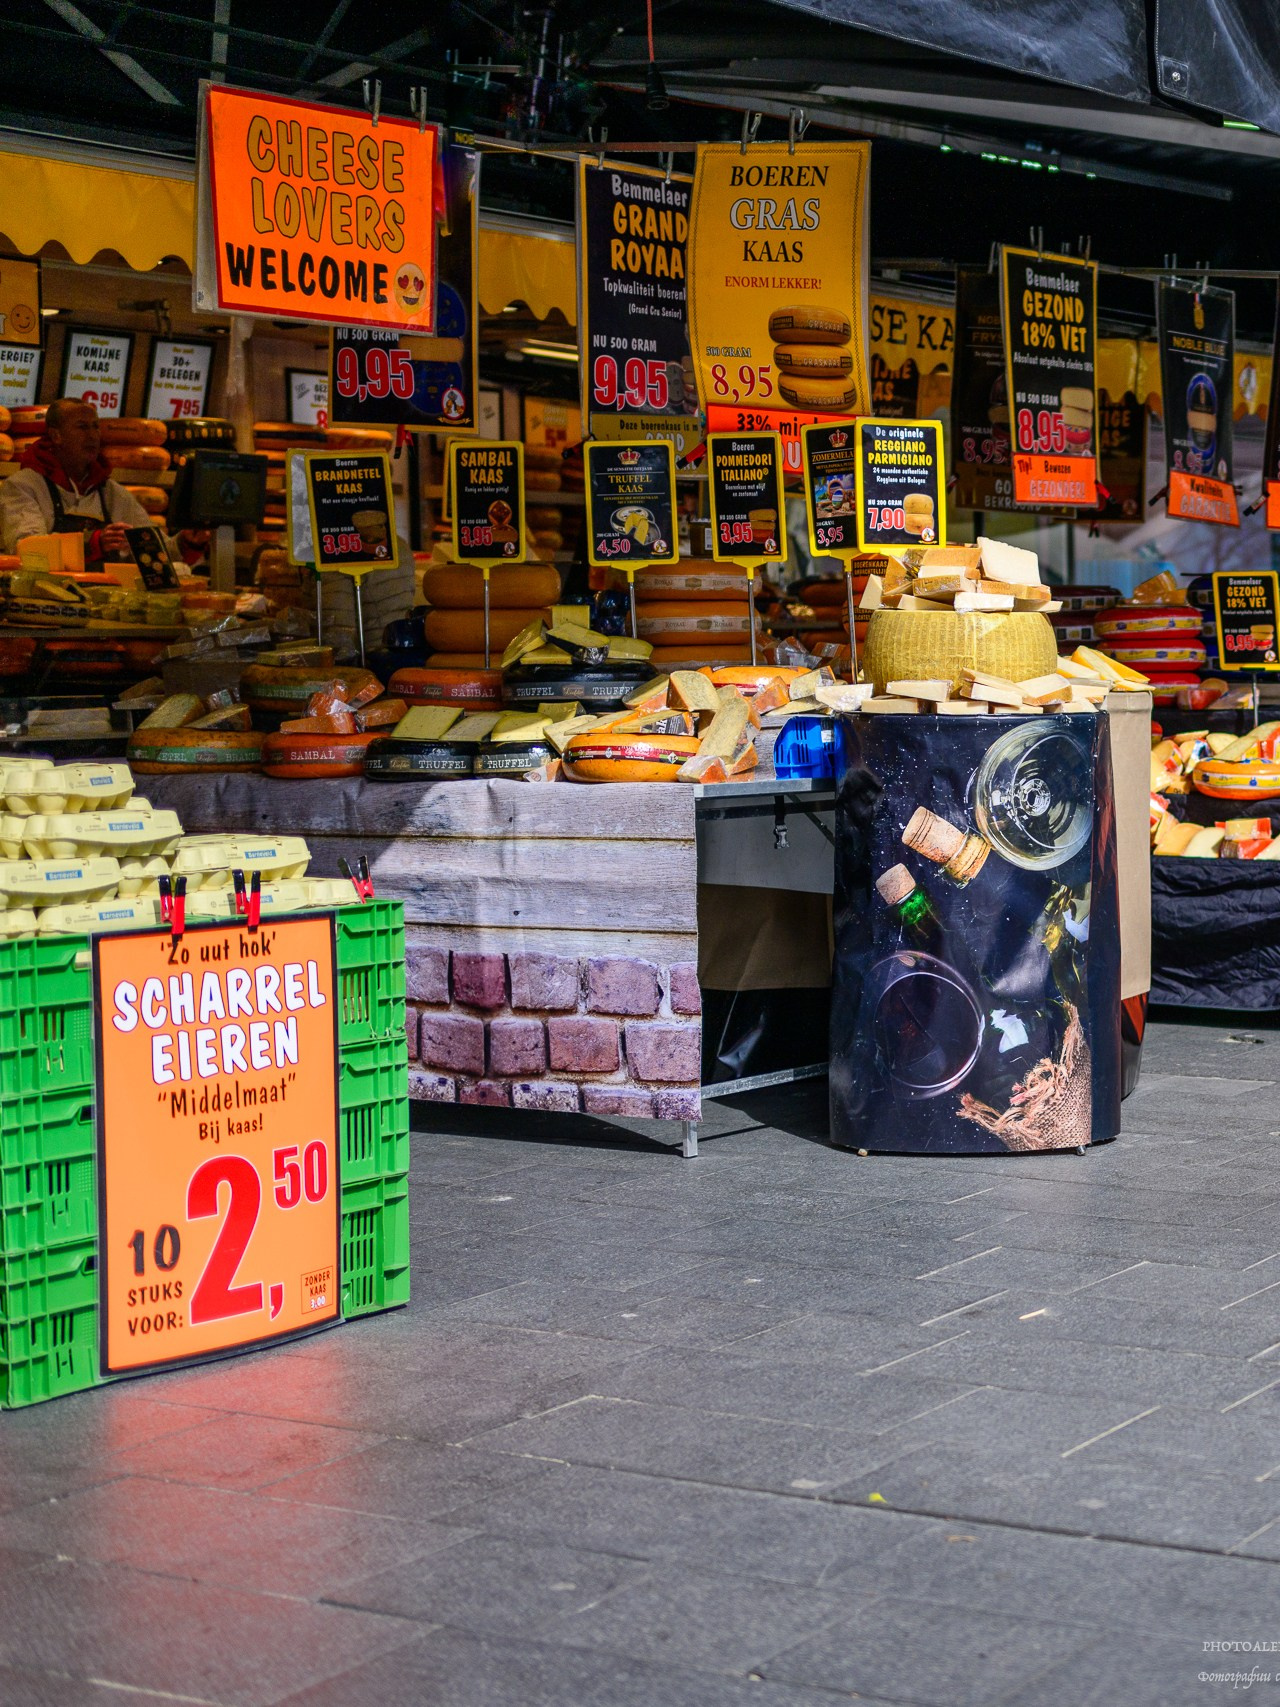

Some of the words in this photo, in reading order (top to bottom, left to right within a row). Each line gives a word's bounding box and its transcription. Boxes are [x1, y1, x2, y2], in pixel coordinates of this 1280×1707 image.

[247, 114, 404, 193] CHEESE
[729, 165, 829, 187] BOEREN
[611, 174, 687, 207] Bemmelaer
[251, 176, 405, 254] LOVERS
[613, 201, 688, 243] GRAND
[730, 197, 821, 230] GRAS
[743, 240, 804, 263] KAAS
[225, 242, 388, 304] WELCOME
[1025, 267, 1080, 293] Bemmelaer
[603, 277, 654, 297] Topkwaliteit
[725, 275, 769, 289] ENORM
[772, 276, 822, 290] LEKKER!
[1022, 289, 1084, 323] GEZOND
[593, 335, 607, 348] NU
[610, 337, 628, 349] 500
[631, 337, 657, 352] GRAM
[1021, 320, 1055, 349] 18%
[1060, 326, 1087, 353] VET
[76, 345, 121, 361] KOMIJNE
[721, 347, 751, 357] GRAM
[1173, 336, 1203, 351] NOBLE
[1204, 342, 1226, 356] BLUE
[84, 359, 110, 373] KAAS
[173, 356, 190, 367] 30+
[159, 367, 201, 381] BELEGEN
[337, 347, 415, 403] 9,95
[594, 354, 668, 412] 9,95
[711, 364, 773, 403] 8,95
[1016, 392, 1026, 403] NU
[1028, 393, 1039, 404] 500
[1041, 394, 1059, 406] GRAM
[620, 419, 638, 430] Deze
[641, 419, 681, 431] boerenkaas
[737, 413, 771, 432] 33%
[1018, 408, 1066, 454] 8,95
[875, 426, 886, 436] De
[888, 427, 924, 440] originele
[732, 442, 754, 451] Boeren
[874, 439, 926, 453] REGGIANO
[335, 459, 358, 467] Boeren
[460, 450, 513, 467] SAMBAL
[716, 453, 772, 467] POMMEDORI
[868, 452, 933, 466] PARMIGIANO
[1017, 457, 1033, 475] Tip!
[1044, 460, 1071, 474] Bewezen
[315, 468, 381, 481] BRANDNETEL
[470, 468, 504, 484] KAAS
[608, 474, 652, 484] TRUFFEL
[336, 483, 363, 494] KAAS
[618, 484, 644, 493] KAAS
[1029, 478, 1086, 499] GEZONDER!
[1190, 478, 1223, 498] Kwaliteits
[1180, 494, 1231, 521] GARANTIE
[868, 507, 905, 531] 7,90
[461, 526, 493, 547] 3,95
[720, 522, 752, 545] 3,95
[817, 526, 844, 546] 3,95
[323, 534, 362, 555] 3,95
[597, 538, 631, 557] 4,50
[1227, 586, 1265, 597] GEZOND
[1226, 597, 1246, 608] 18%
[1249, 597, 1267, 607] VET
[1225, 634, 1255, 652] 8,95
[450, 687, 496, 698] SAMBAL
[516, 686, 554, 696] TRUFFEL
[290, 750, 336, 760] SAMBAL
[487, 758, 532, 769] TRUFFEL
[418, 760, 466, 769] TRUFFEL
[110, 822, 141, 831] Barneveld
[49, 871, 80, 881] Barneveld
[100, 910, 132, 920] Barneveld
[201, 940, 230, 963] uut
[112, 959, 326, 1033] SCHARREL
[151, 1016, 299, 1085] EIEREN
[199, 1121, 221, 1142] Bij
[227, 1118, 264, 1137] kaas!
[127, 1225, 181, 1276] 10
[304, 1270, 331, 1287] ZONDER
[127, 1282, 183, 1307] STUKS
[310, 1283, 327, 1297] KAAS
[127, 1313, 184, 1336] VOOR:
